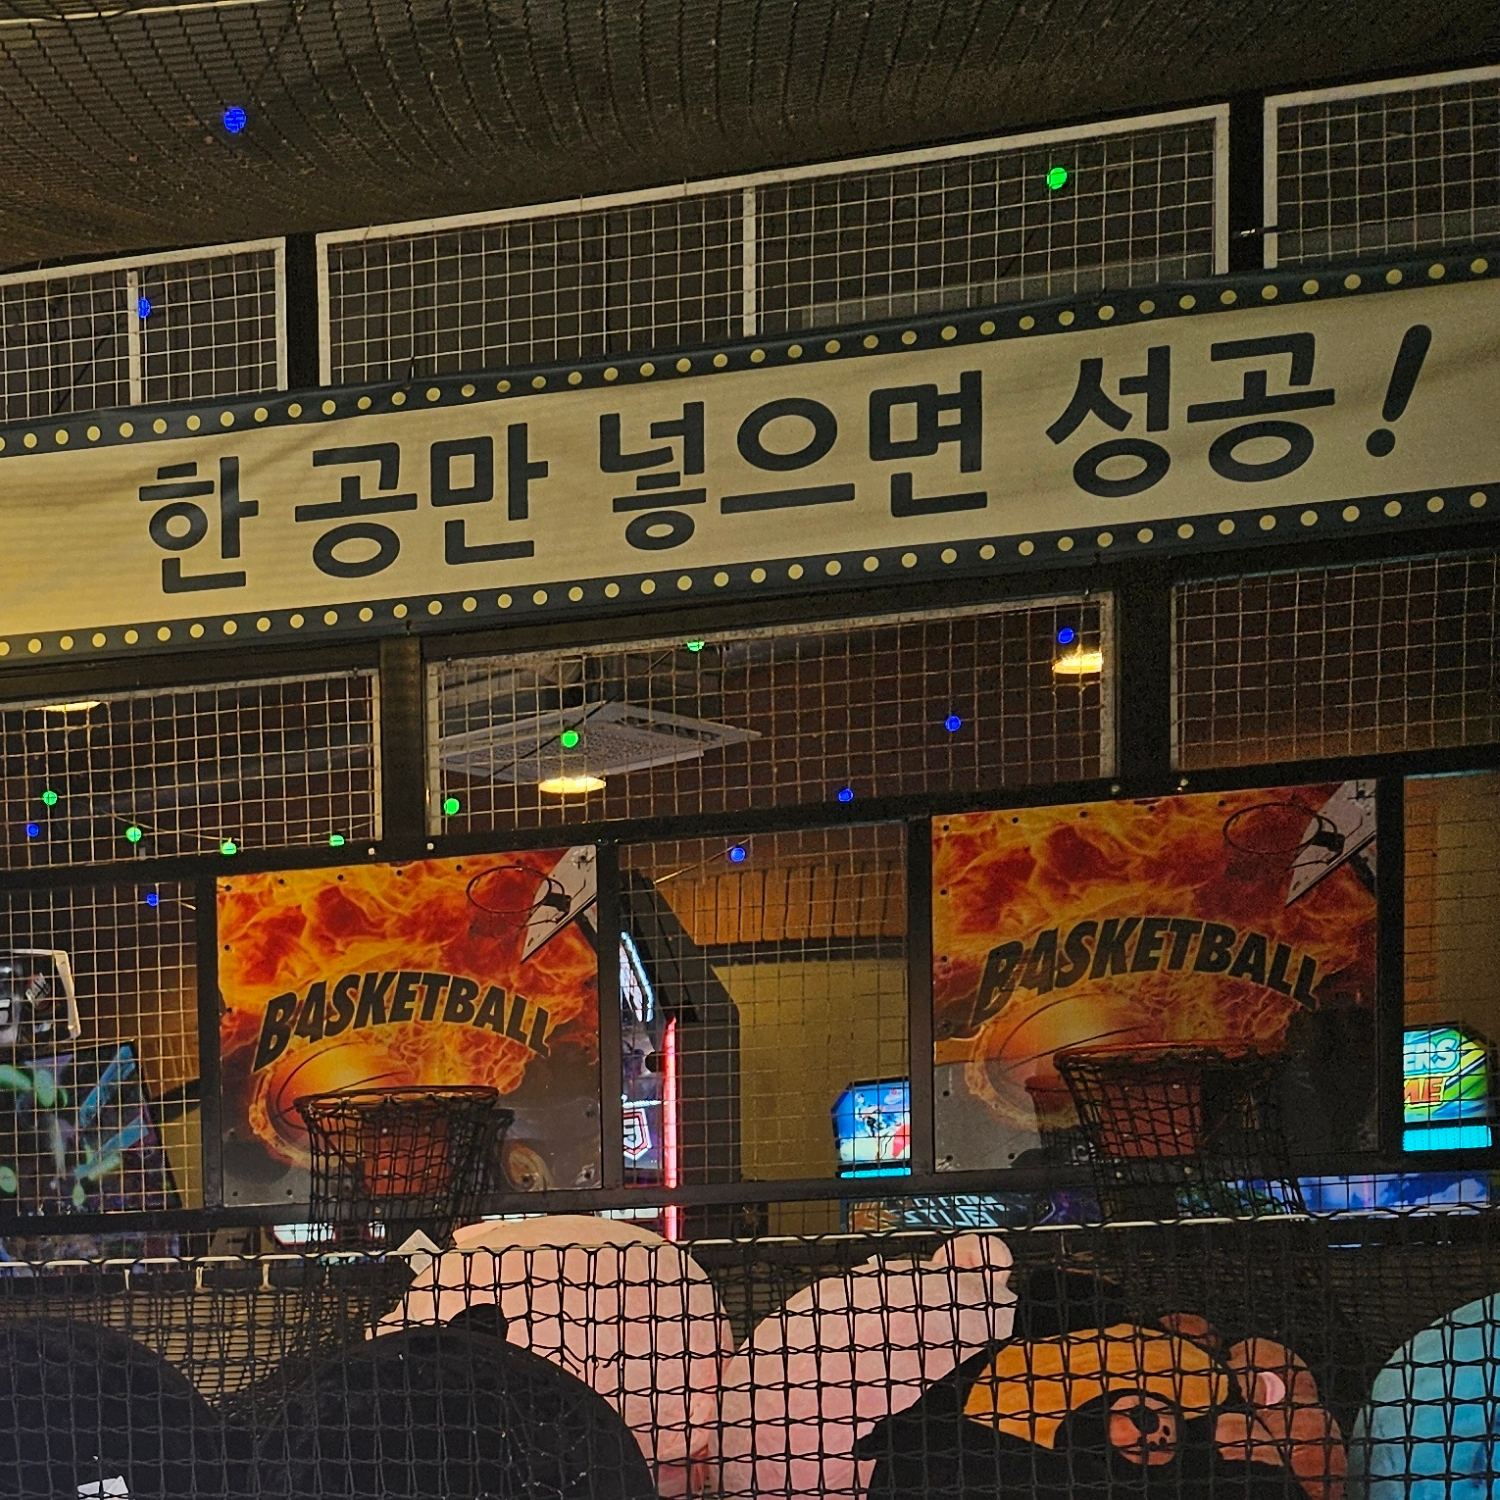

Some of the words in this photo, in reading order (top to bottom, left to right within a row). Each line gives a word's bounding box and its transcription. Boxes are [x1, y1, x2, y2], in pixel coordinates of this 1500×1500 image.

[138, 456, 259, 593] 한
[295, 423, 549, 579] 공만
[597, 370, 988, 551] 넣으면
[1045, 324, 1433, 498] 성공!
[252, 970, 551, 1073] BASKETBALL
[969, 916, 1320, 1028] BASKETBALL
